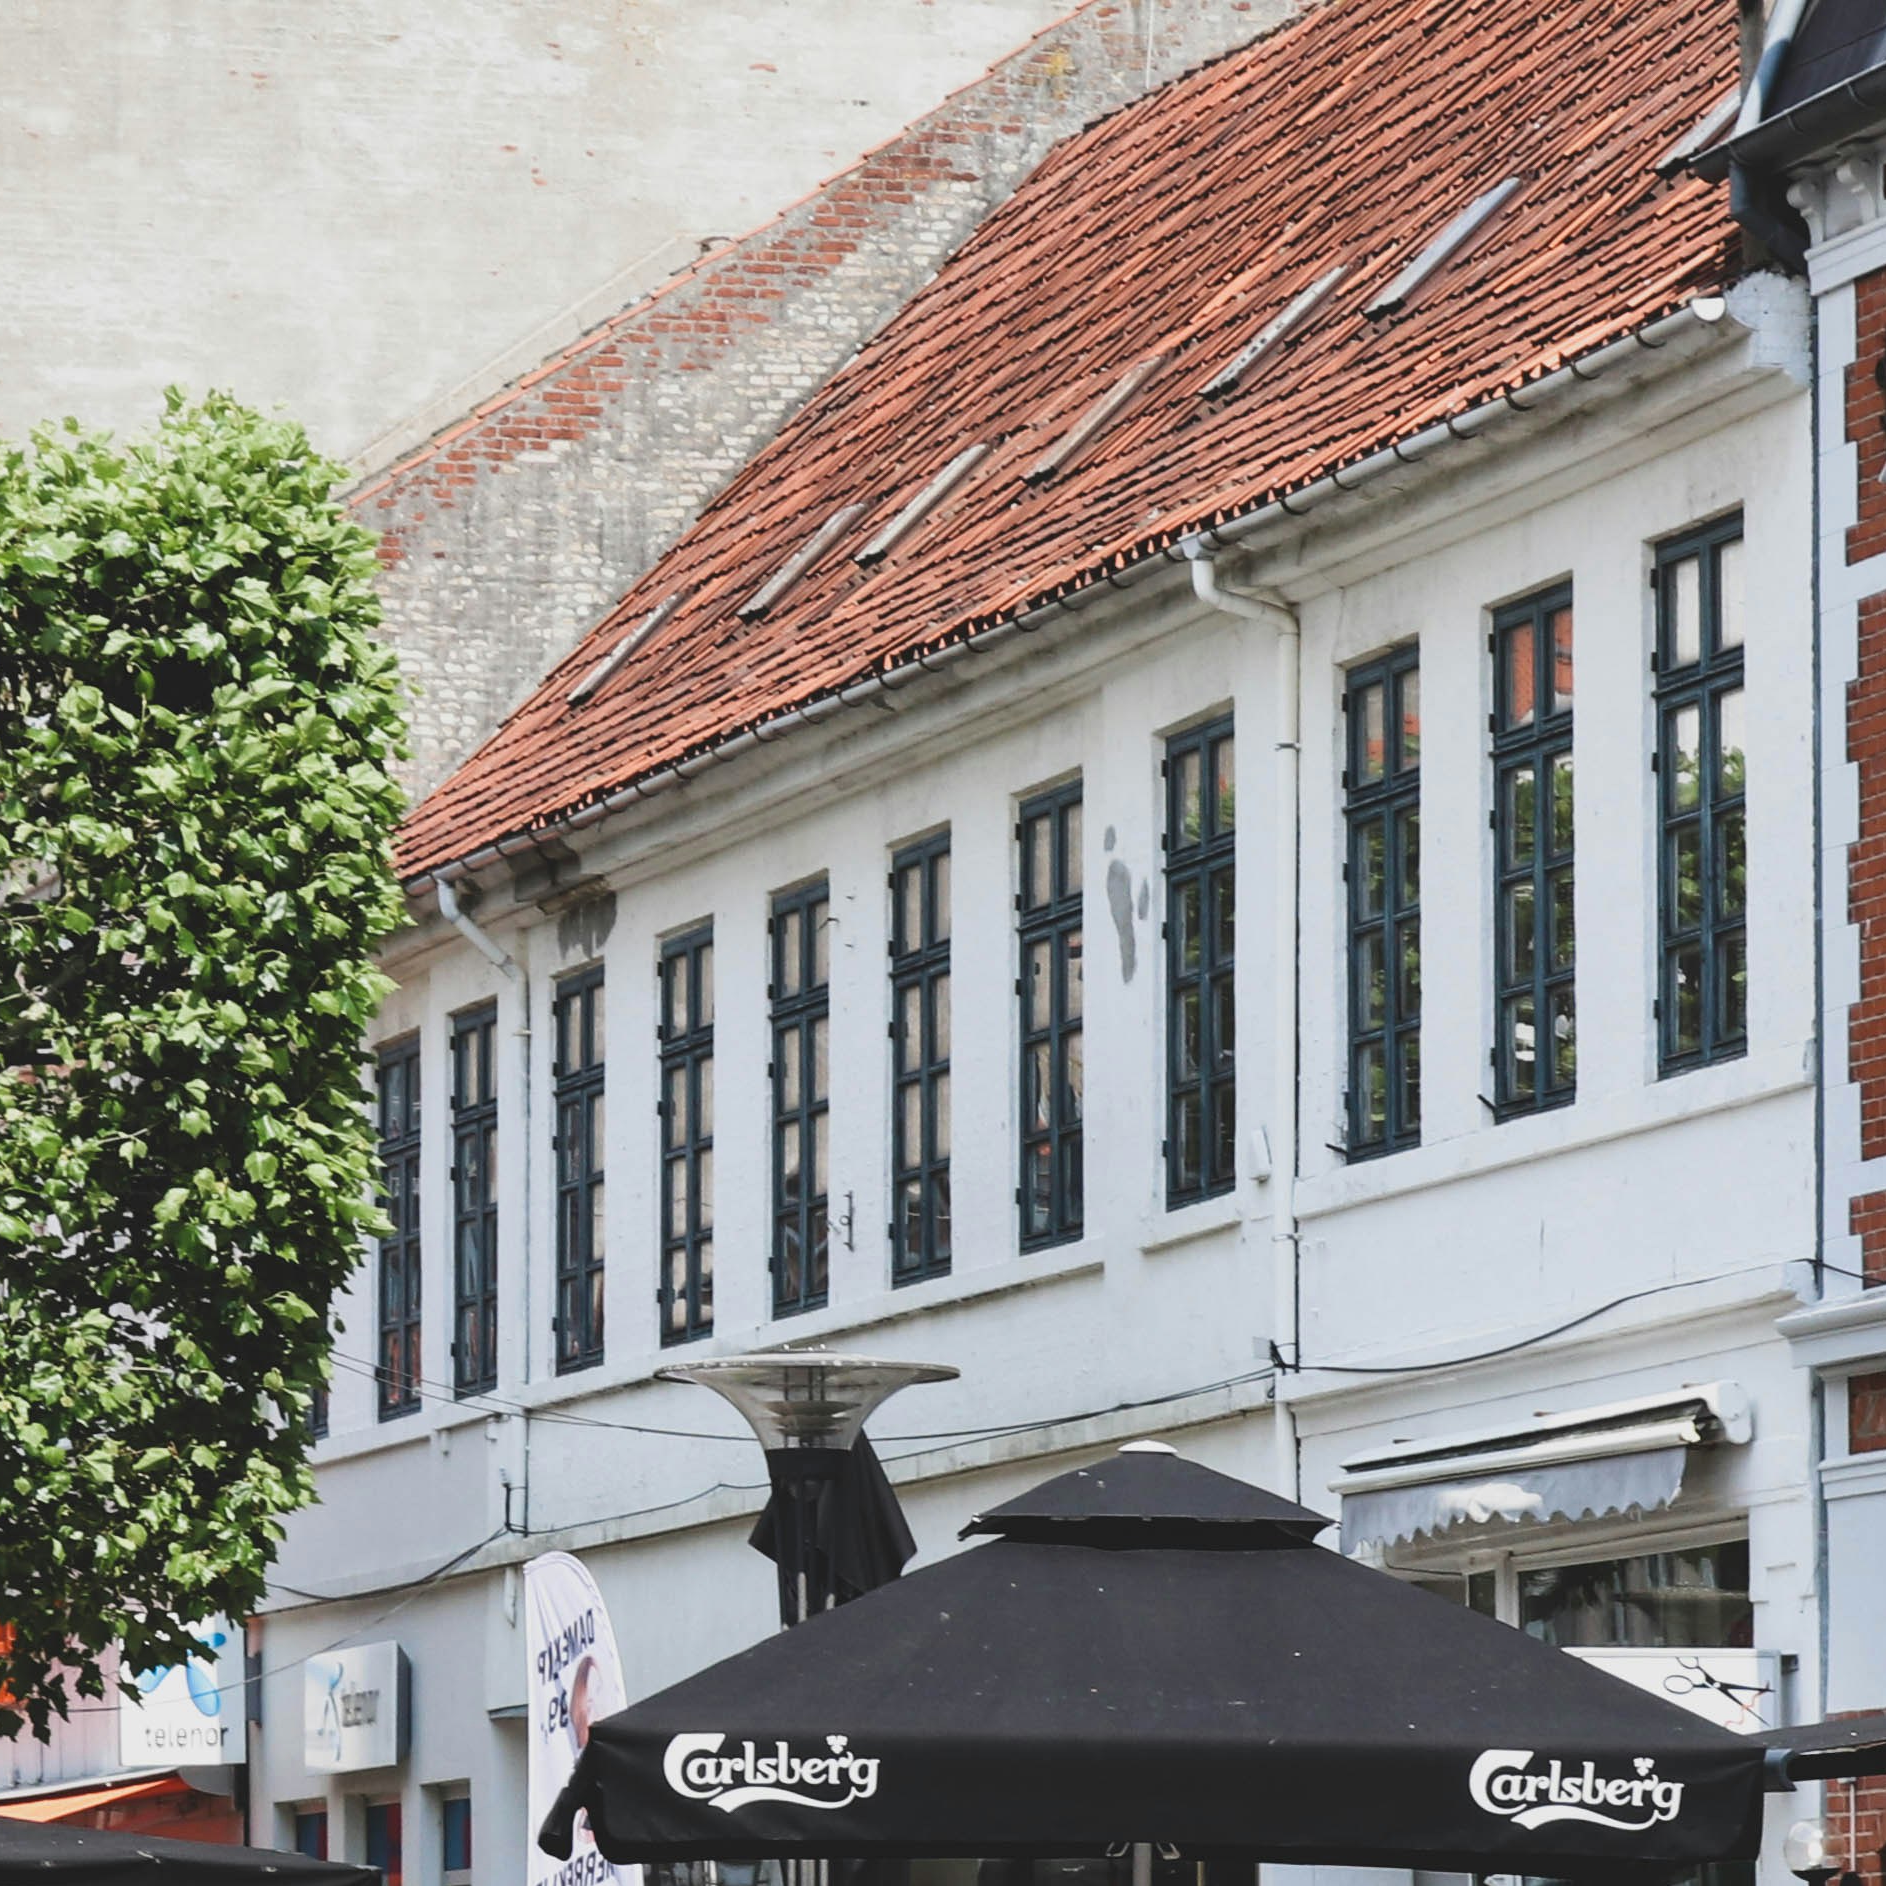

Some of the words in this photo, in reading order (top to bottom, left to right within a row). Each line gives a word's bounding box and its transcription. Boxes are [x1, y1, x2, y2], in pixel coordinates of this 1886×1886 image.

[144, 1723, 229, 1750] telenor
[662, 1732, 880, 1801] Carlsberg
[1468, 1748, 1685, 1822] Carlsberg
